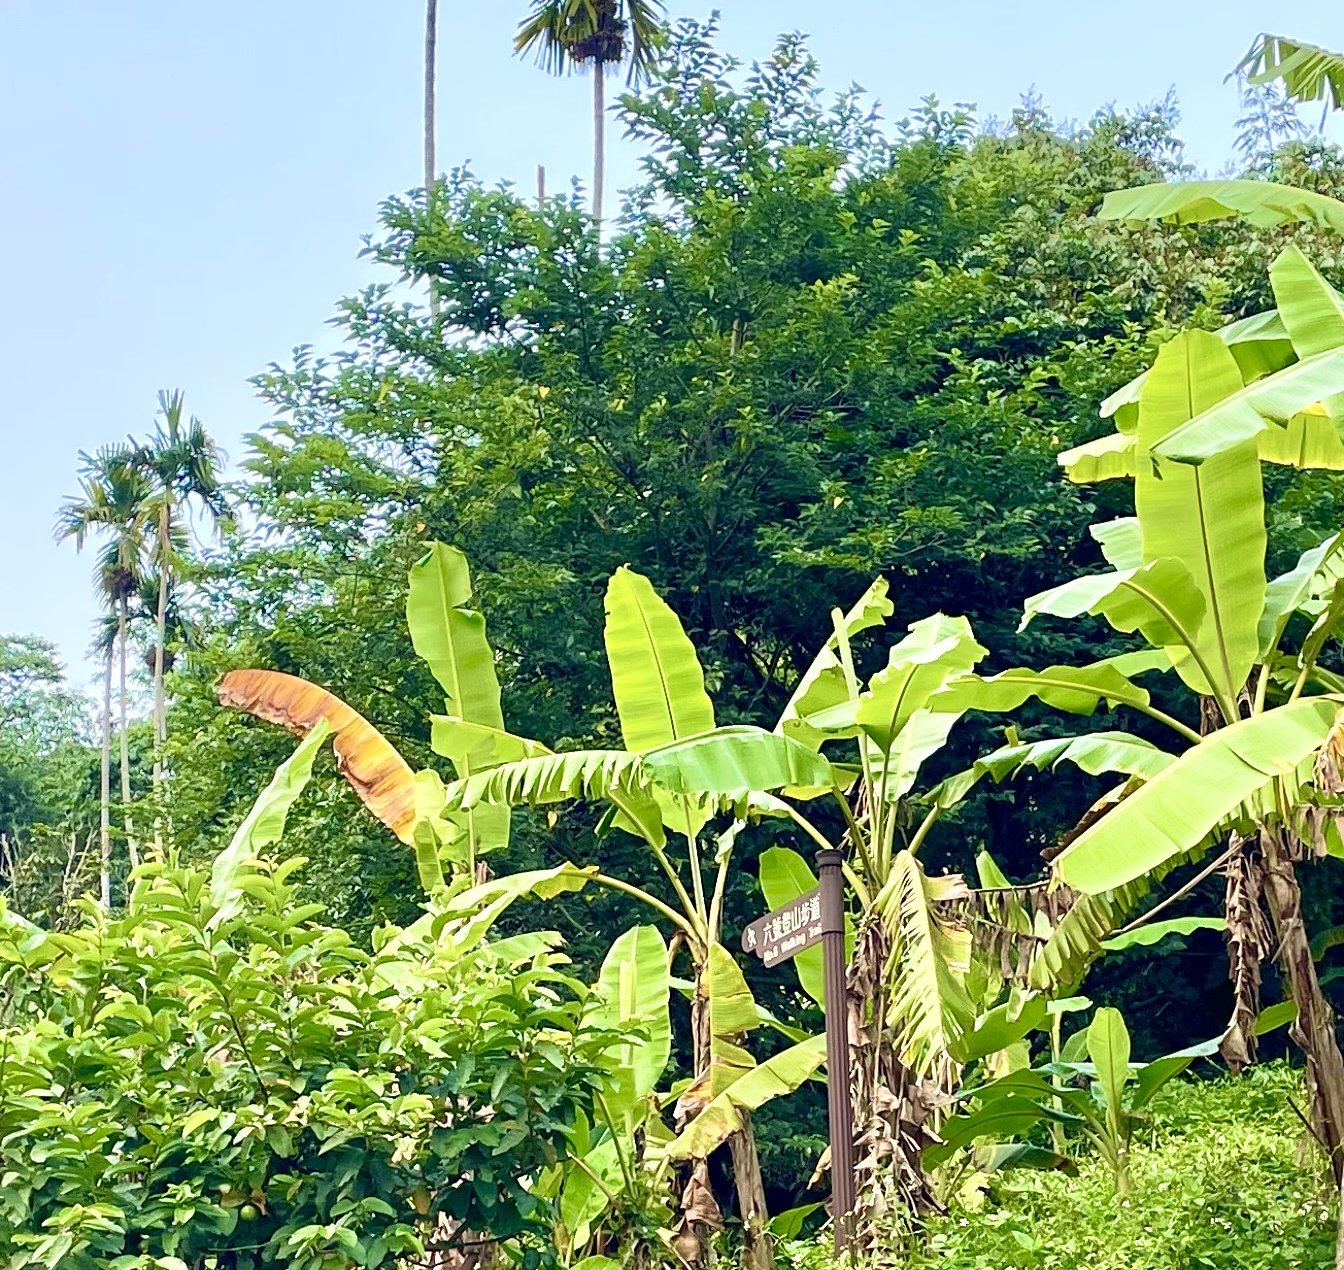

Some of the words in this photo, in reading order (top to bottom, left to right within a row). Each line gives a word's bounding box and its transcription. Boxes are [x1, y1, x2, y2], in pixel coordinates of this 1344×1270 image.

[763, 895, 821, 946] 六號登山步道
